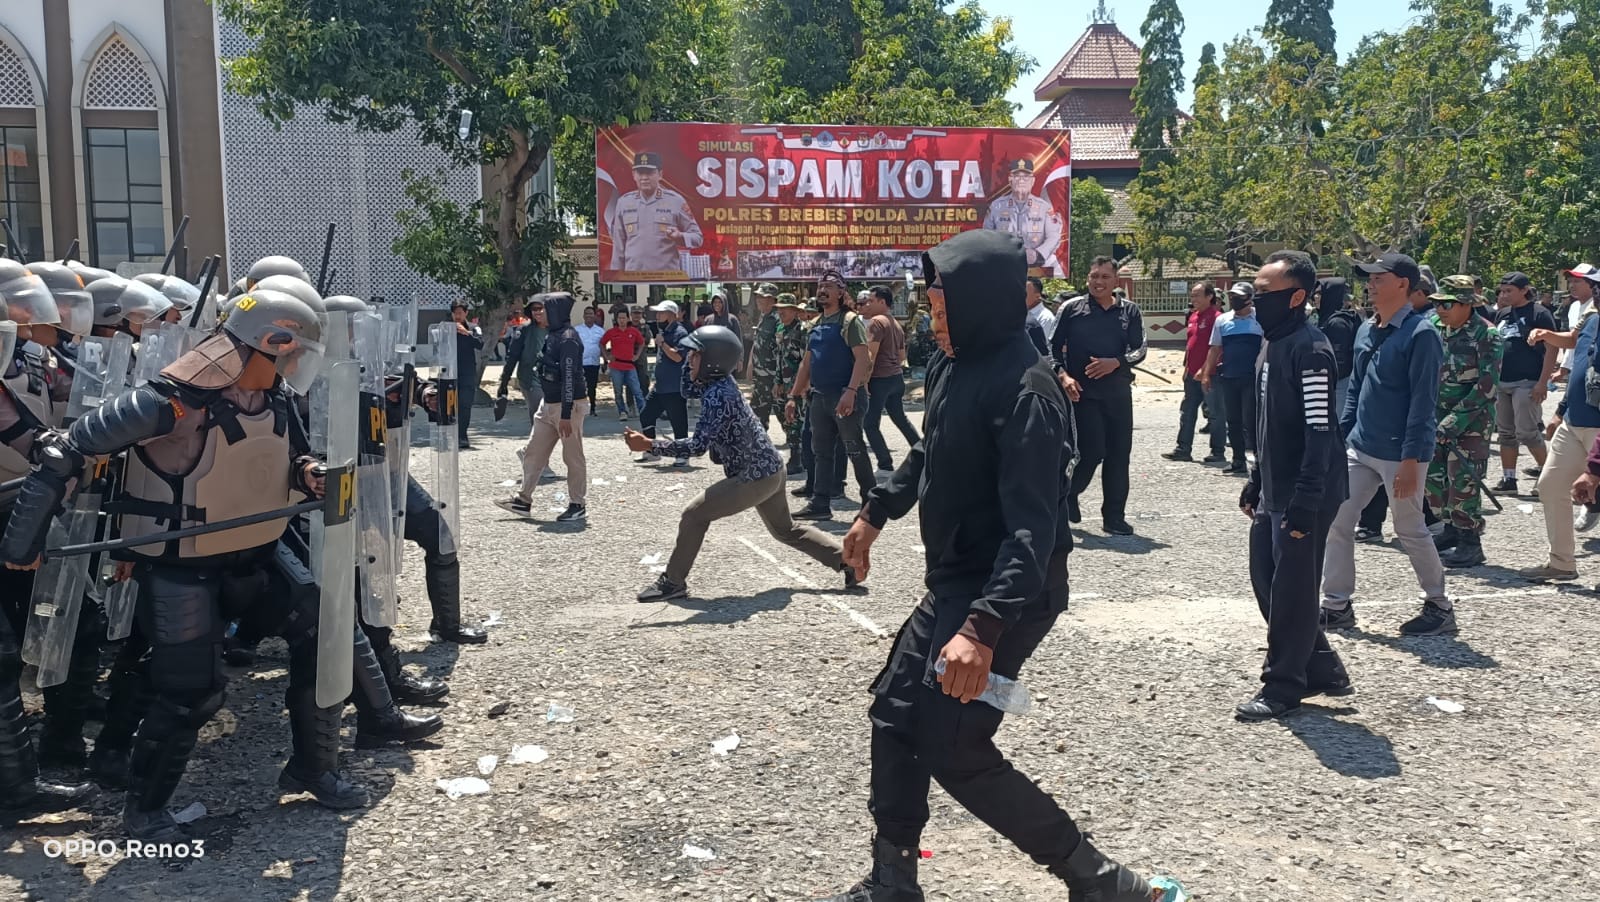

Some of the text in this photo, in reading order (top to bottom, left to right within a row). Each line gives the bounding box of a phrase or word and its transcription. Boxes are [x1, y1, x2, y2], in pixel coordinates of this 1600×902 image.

[698, 141, 754, 152] SIMULASI
[696, 157, 986, 199] SISPAM KOTA
[703, 207, 978, 222] POLRES BREBES POLDA JATENG
[715, 224, 961, 236] Kesiapan Pengamanan Pemilihan Gubernur dan Wakil Gubernur
[737, 235, 941, 247] serta Pemilihan Bupati dan Wakil Bupati Tahun 2024
